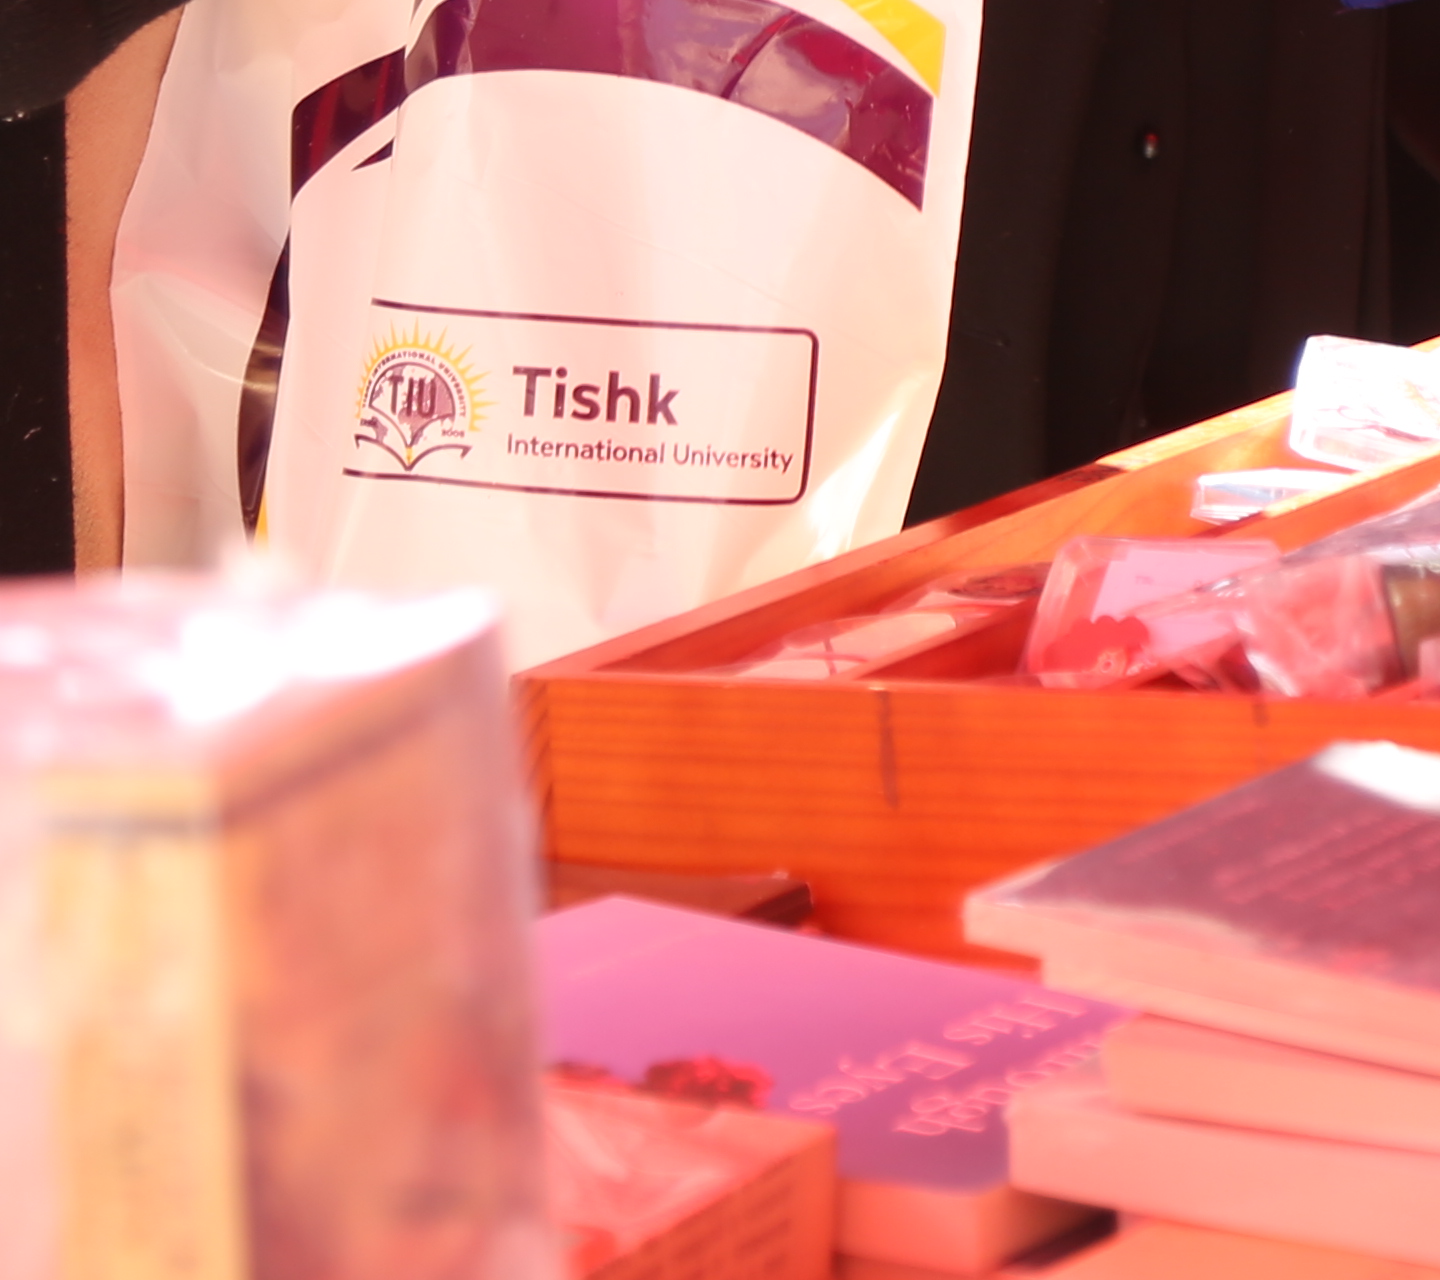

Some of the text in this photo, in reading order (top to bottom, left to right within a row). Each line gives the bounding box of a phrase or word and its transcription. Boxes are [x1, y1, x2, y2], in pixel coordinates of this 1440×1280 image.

[387, 373, 437, 419] TIU
[512, 366, 680, 426] Tishk
[507, 433, 794, 474] International University
[788, 989, 1089, 1117] His Eyes
